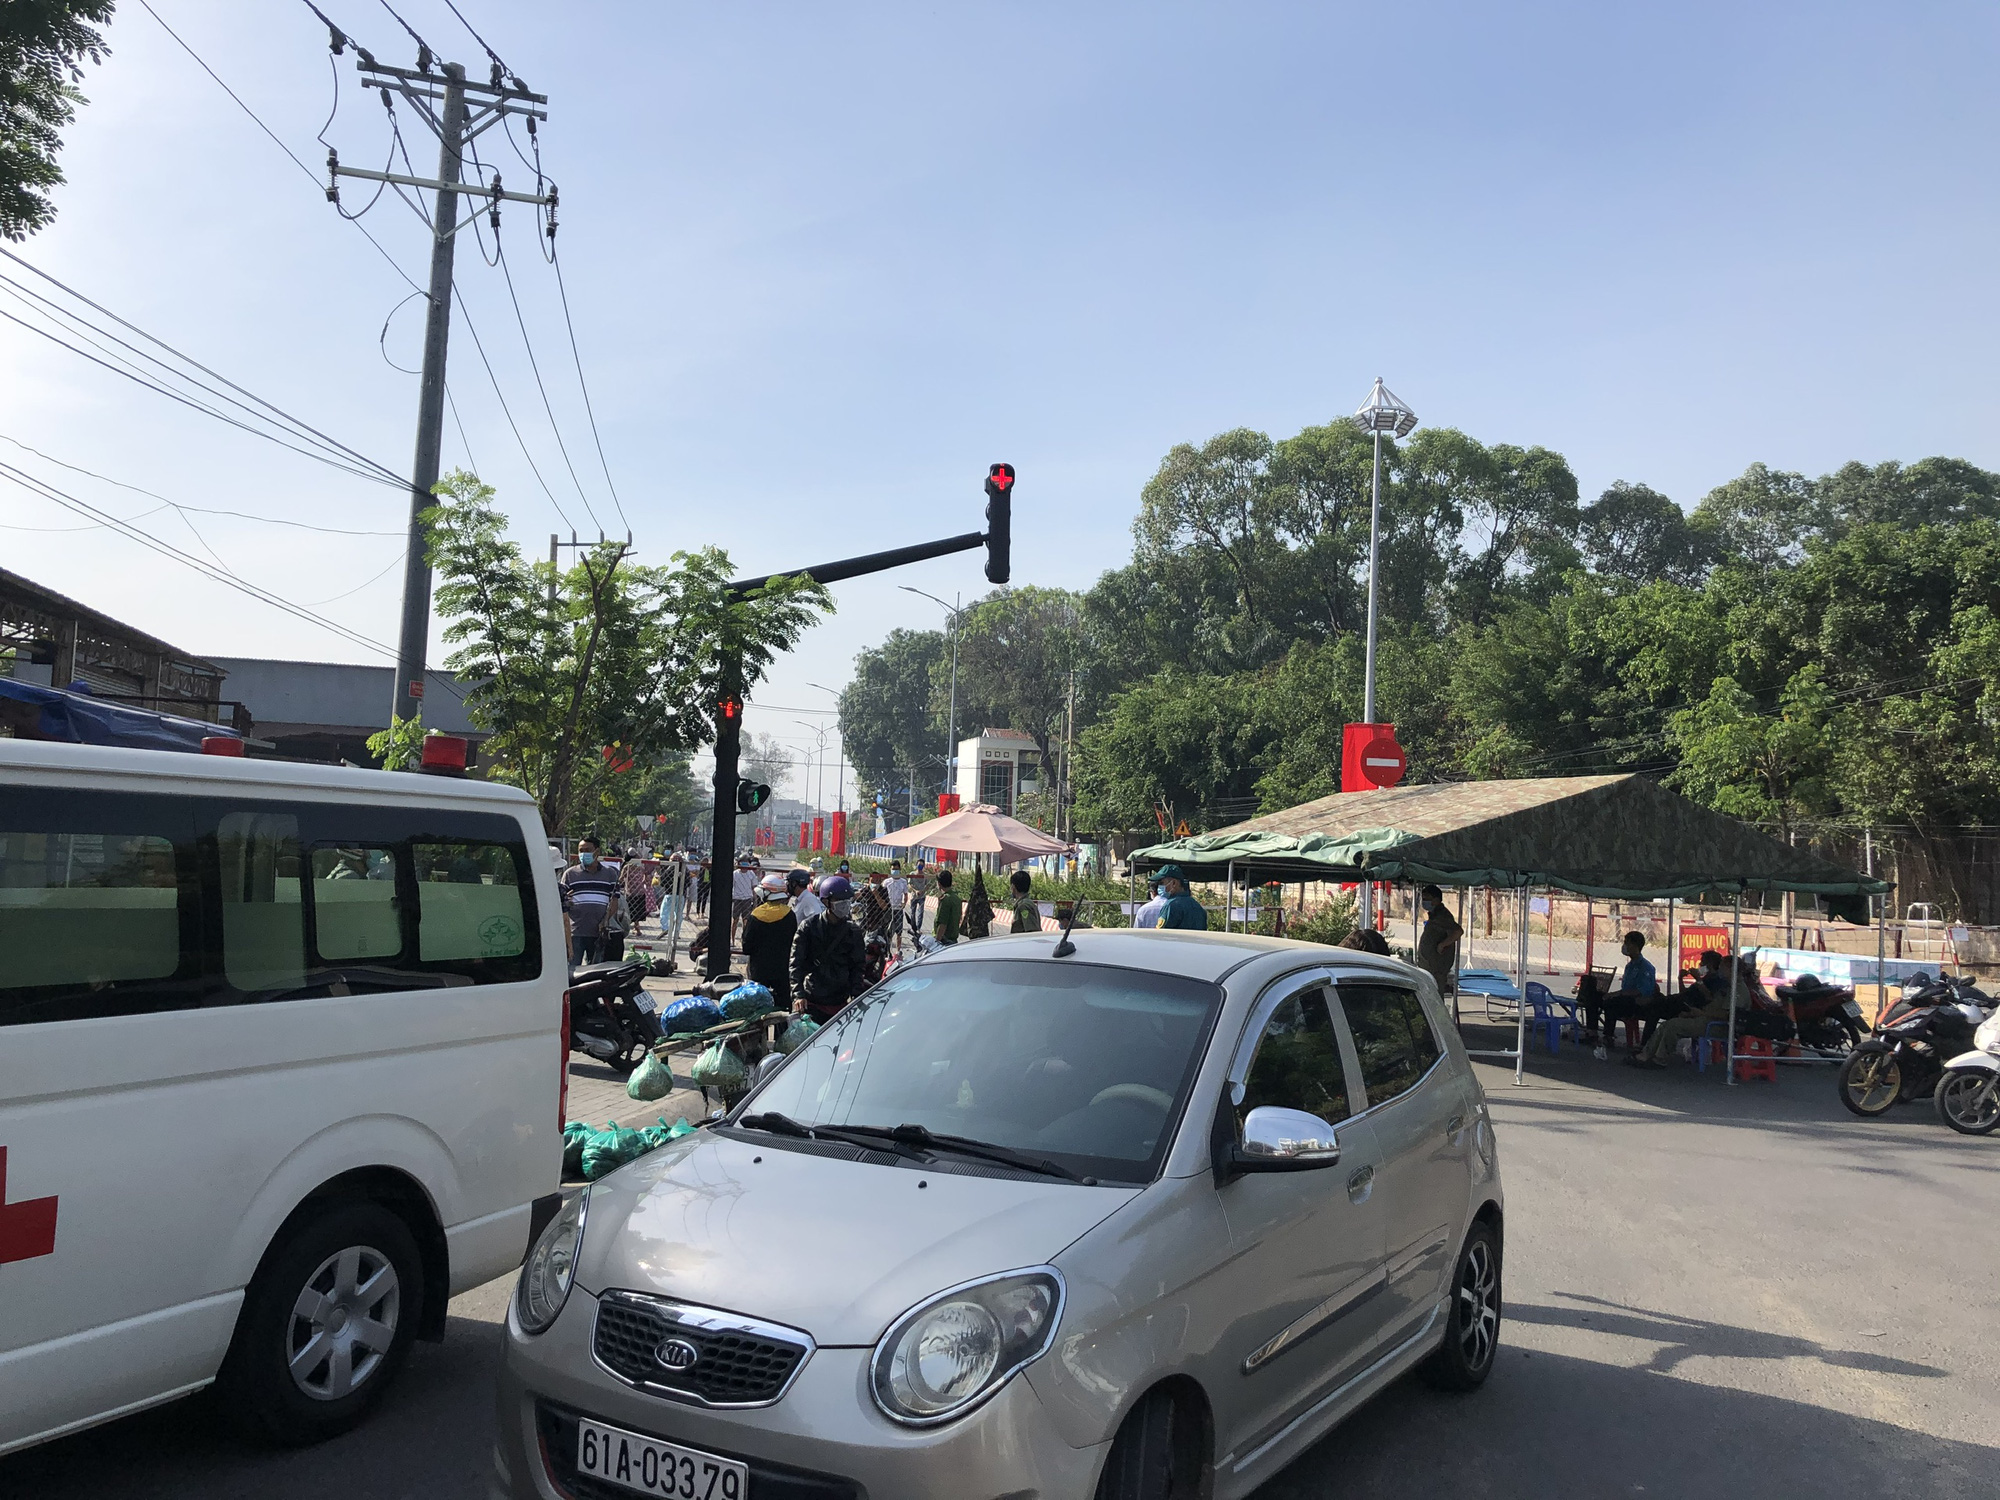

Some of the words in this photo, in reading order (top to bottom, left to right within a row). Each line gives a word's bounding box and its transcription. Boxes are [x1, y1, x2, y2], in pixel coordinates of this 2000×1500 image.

[1682, 934, 1703, 948] KHU
[1706, 933, 1726, 949] VỰC
[660, 1344, 688, 1365] KIA
